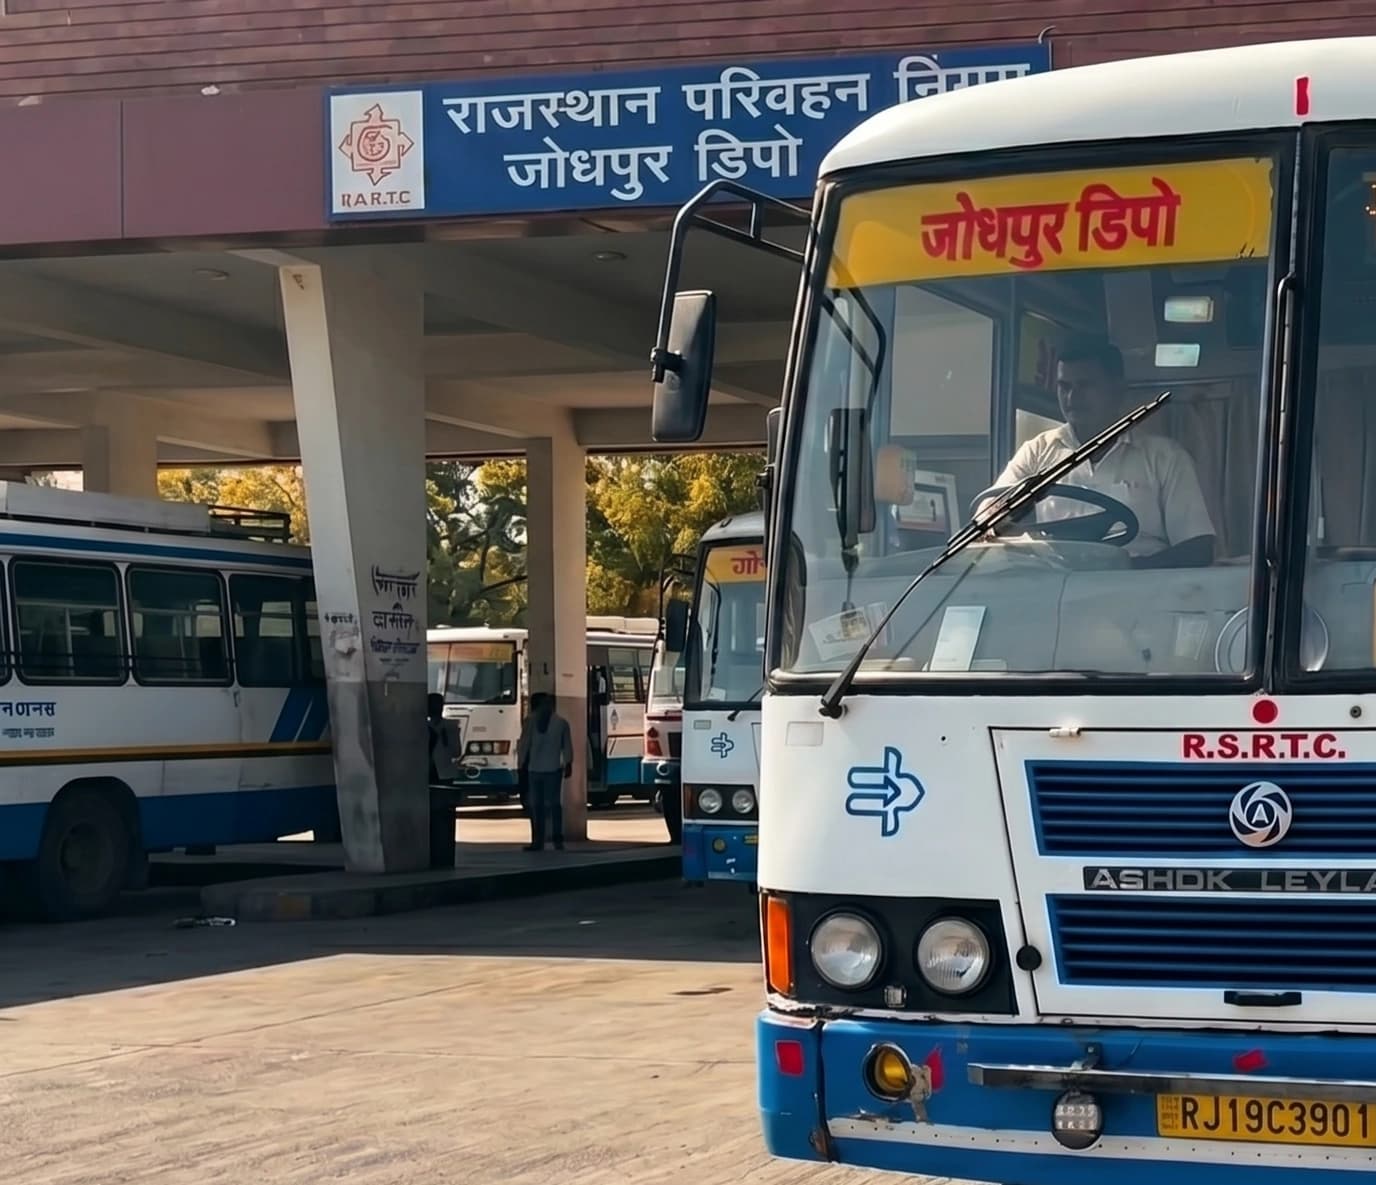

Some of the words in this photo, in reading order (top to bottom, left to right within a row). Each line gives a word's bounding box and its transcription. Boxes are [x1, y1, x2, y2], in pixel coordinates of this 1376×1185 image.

[442, 86, 662, 135] राजस्थान
[681, 66, 871, 120] परिवहन
[893, 54, 1031, 104] नि
[503, 136, 673, 201] जोधपुर
[694, 124, 803, 182] डिपो
[920, 191, 1069, 269] जोधपुर
[1075, 177, 1181, 252] डिपो
[1183, 734, 1346, 759] R.S.R.T.C.
[1181, 1096, 1369, 1139] RJ19C3901
